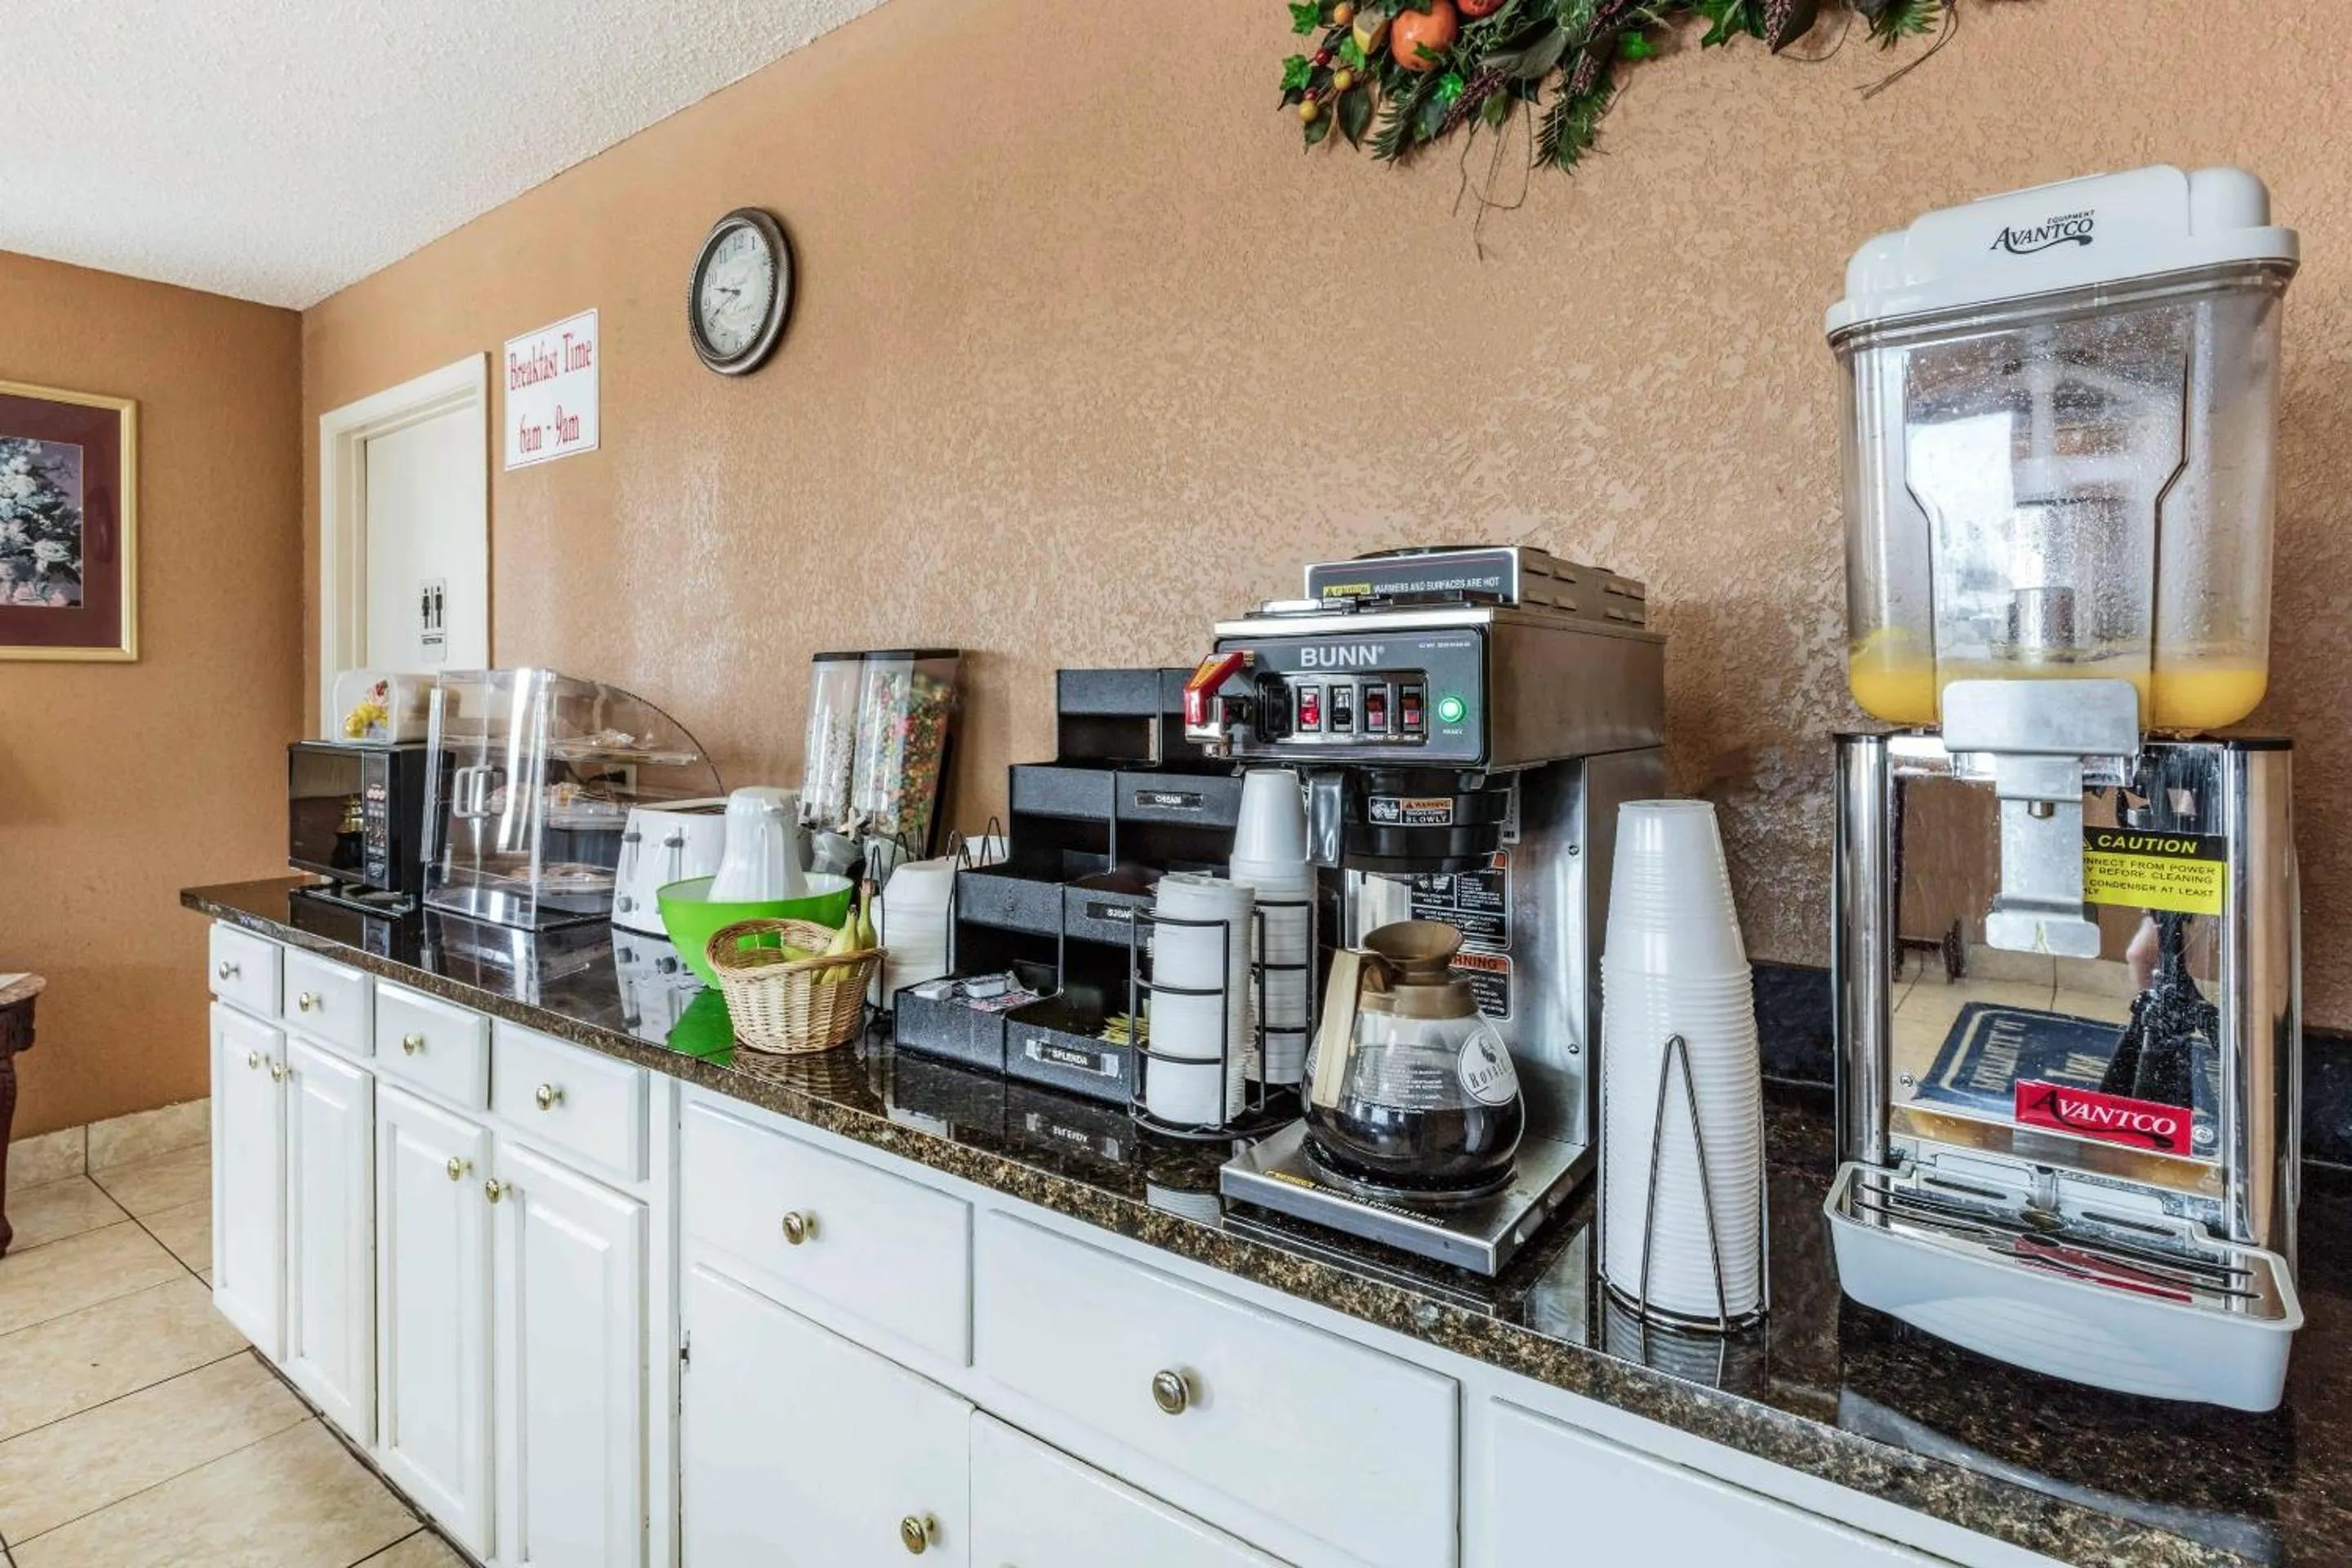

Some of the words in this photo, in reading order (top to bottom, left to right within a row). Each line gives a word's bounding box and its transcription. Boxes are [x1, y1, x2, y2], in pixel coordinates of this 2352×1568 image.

[2047, 209, 2095, 224] EQUIPMENT
[733, 234, 744, 251] 12
[750, 236, 755, 250] 1
[1989, 218, 2093, 252] AVANTCO
[719, 248, 728, 264] 11
[707, 272, 717, 287] 10
[510, 340, 558, 391] Breakfast
[563, 332, 592, 373] Time
[519, 413, 542, 453] 6am
[555, 404, 580, 446] 9am
[1374, 582, 1408, 594] WARMERS
[1410, 581, 1424, 591] AND
[1427, 579, 1465, 591] SURFACES
[1466, 578, 1482, 588] ARE
[1483, 577, 1500, 587] HOT
[2097, 835, 2198, 854] CAUTION
[2099, 867, 2145, 879] BEFORE
[2151, 871, 2213, 884] CLEANING
[2130, 862, 2165, 871] FROM
[2170, 863, 2216, 875] POWER
[2089, 879, 2156, 893] CONDENSER
[1052, 1050, 1088, 1066] SPLENDA
[2032, 1090, 2177, 1138] AVANTCO
